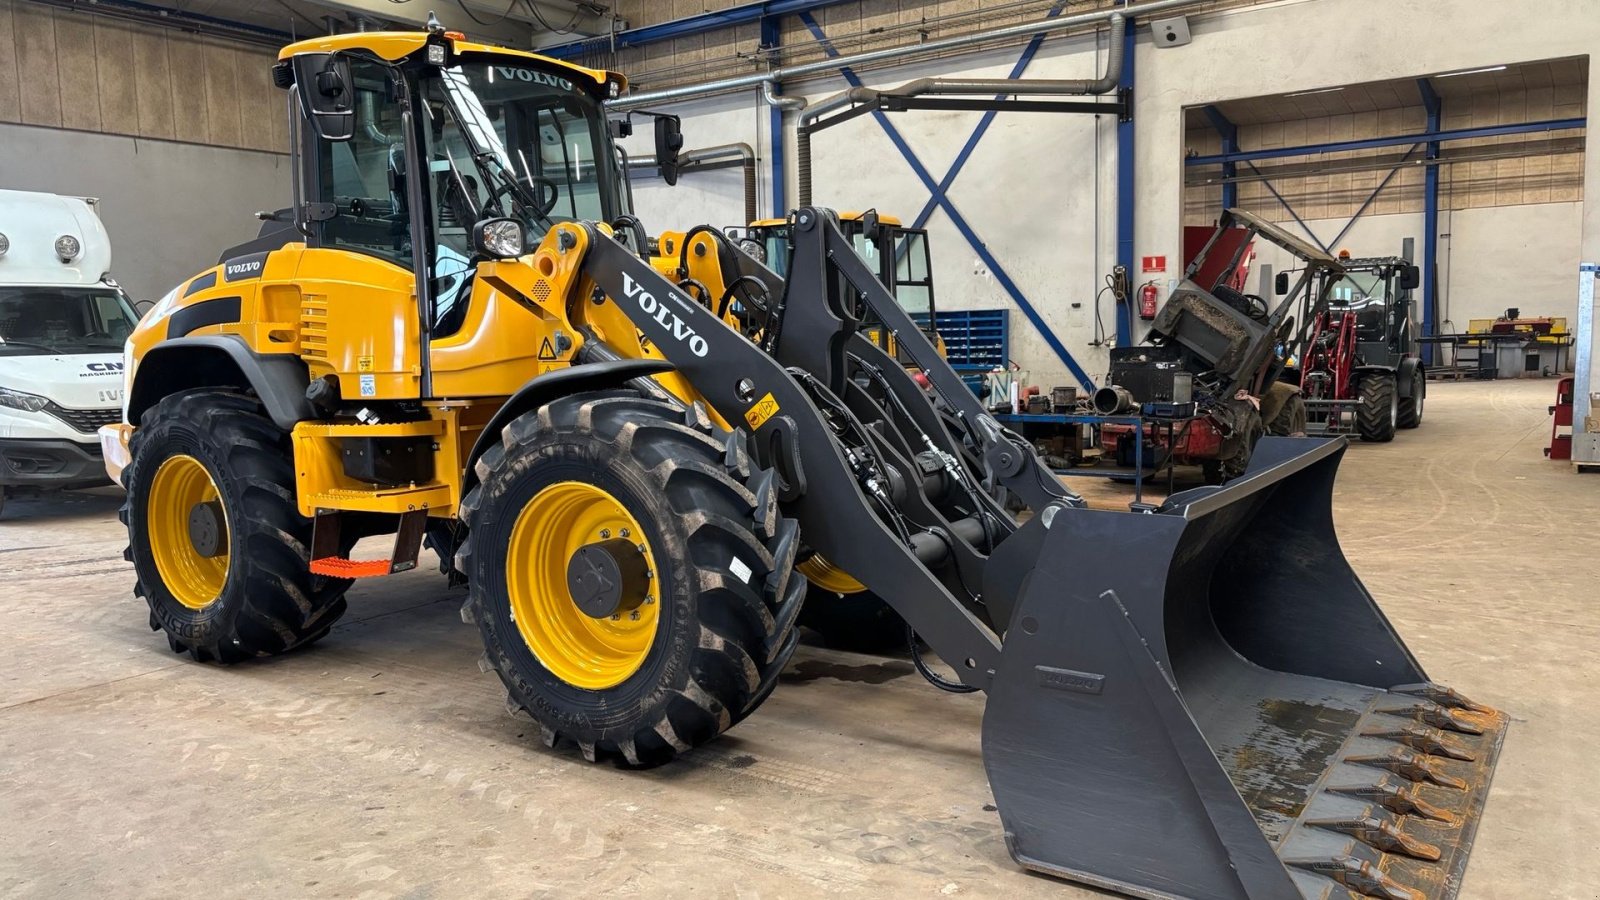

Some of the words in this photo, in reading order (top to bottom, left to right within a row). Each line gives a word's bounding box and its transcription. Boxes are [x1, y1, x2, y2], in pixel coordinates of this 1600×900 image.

[495, 66, 572, 91] VOLVO
[228, 261, 260, 274] VOLVO
[621, 271, 709, 358] VOLVO
[86, 362, 124, 371] CN
